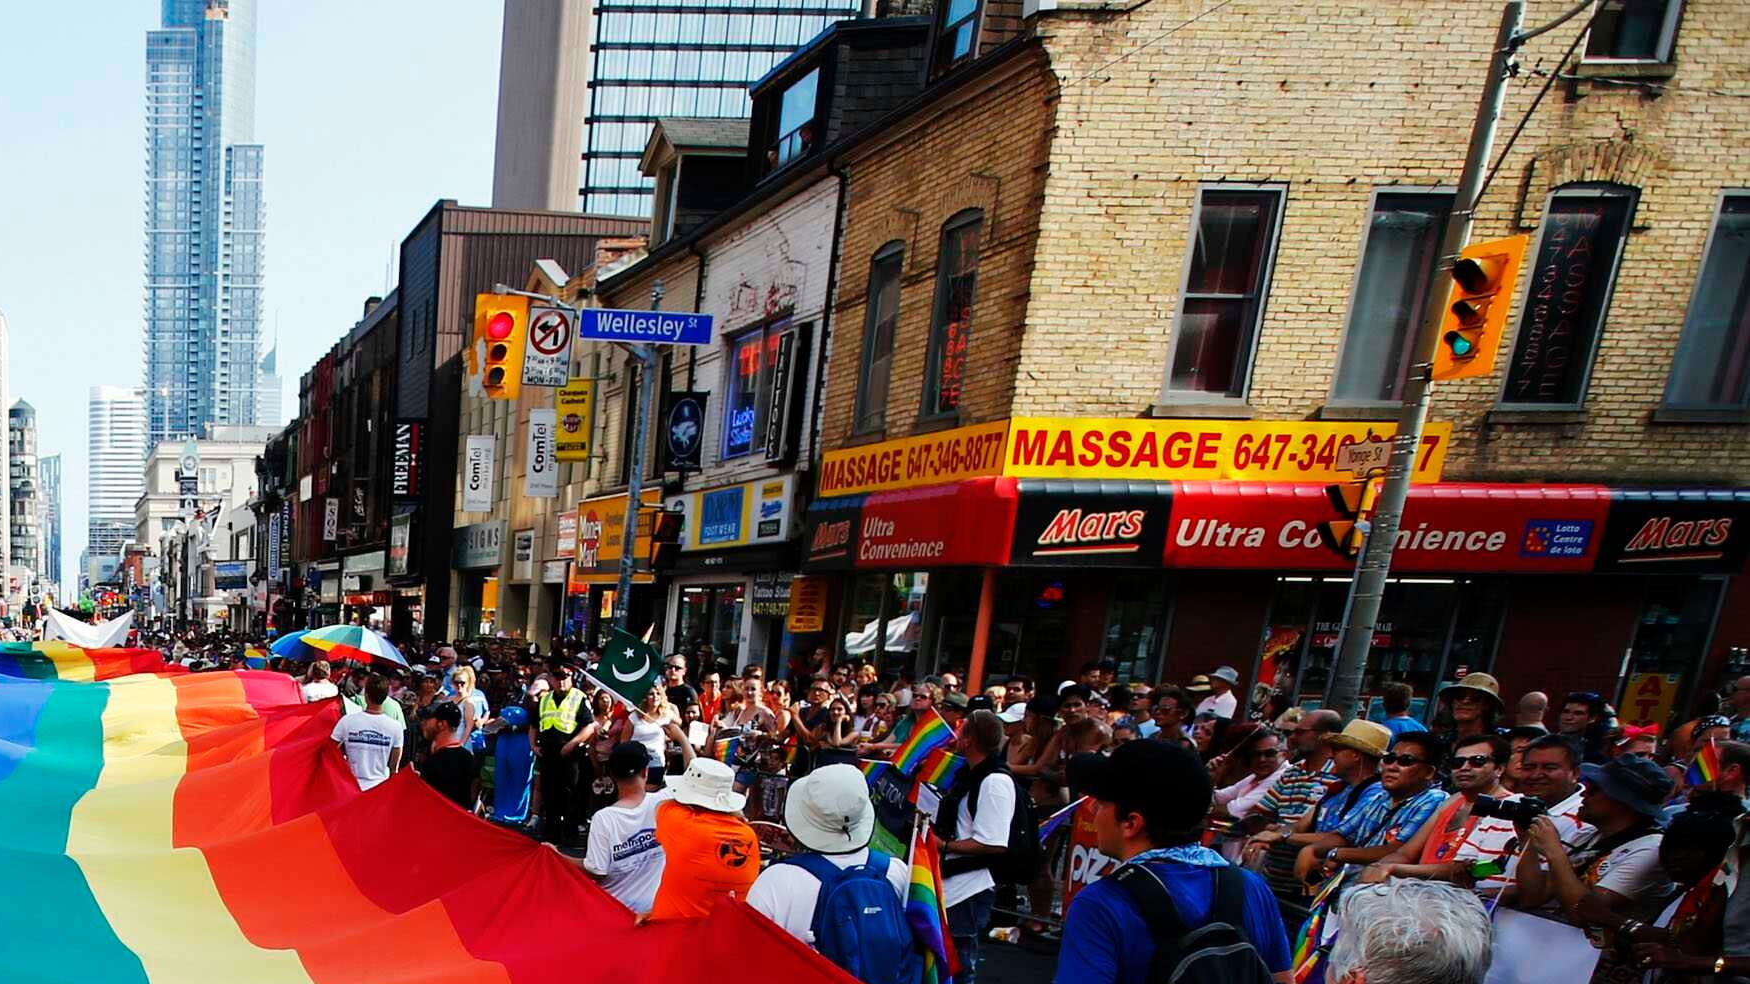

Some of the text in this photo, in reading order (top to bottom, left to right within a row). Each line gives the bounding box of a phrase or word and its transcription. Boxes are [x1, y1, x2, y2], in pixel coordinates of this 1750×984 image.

[596, 312, 698, 341] Wellesley St
[393, 423, 410, 495] FREEMAN
[532, 423, 547, 473] ComTel
[821, 431, 1004, 491] MASSAGE 647-346-8877
[1012, 429, 1440, 472] MASSAGE 647-347
[469, 447, 481, 491] ComTel
[811, 519, 850, 551] Mars
[863, 516, 895, 538] Ultra
[1037, 508, 1147, 545] Mars
[1175, 518, 1506, 551] Ultra Conience
[1552, 534, 1584, 543] Centre
[1624, 516, 1732, 552] Mars
[578, 541, 598, 568] Mart
[860, 537, 944, 560] Convenience
[1550, 545, 1561, 554] de
